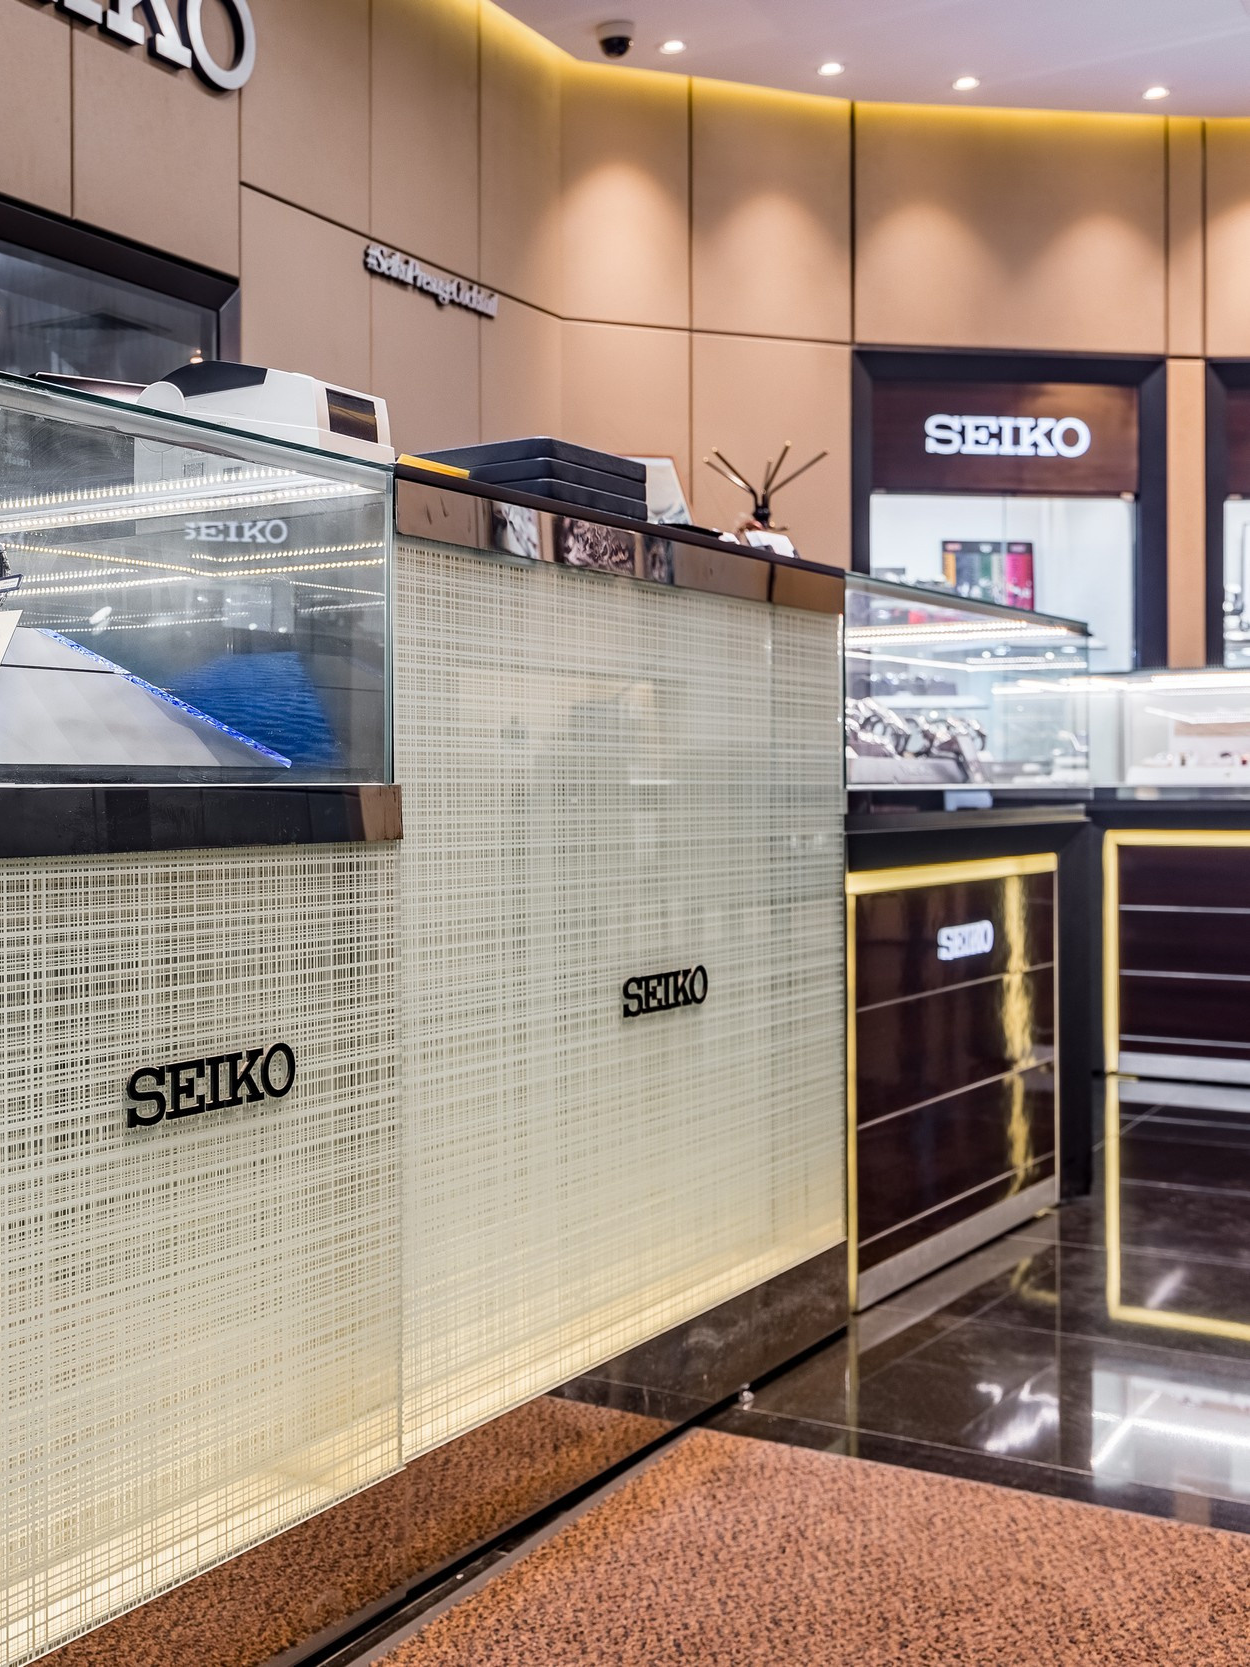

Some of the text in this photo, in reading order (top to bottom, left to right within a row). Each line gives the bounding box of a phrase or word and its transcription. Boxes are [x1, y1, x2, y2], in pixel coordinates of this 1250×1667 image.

[924, 414, 1091, 458] SEIKO
[184, 518, 288, 545] SEIKO
[622, 964, 708, 1018] SEIKO
[126, 1042, 296, 1128] SEIKO
